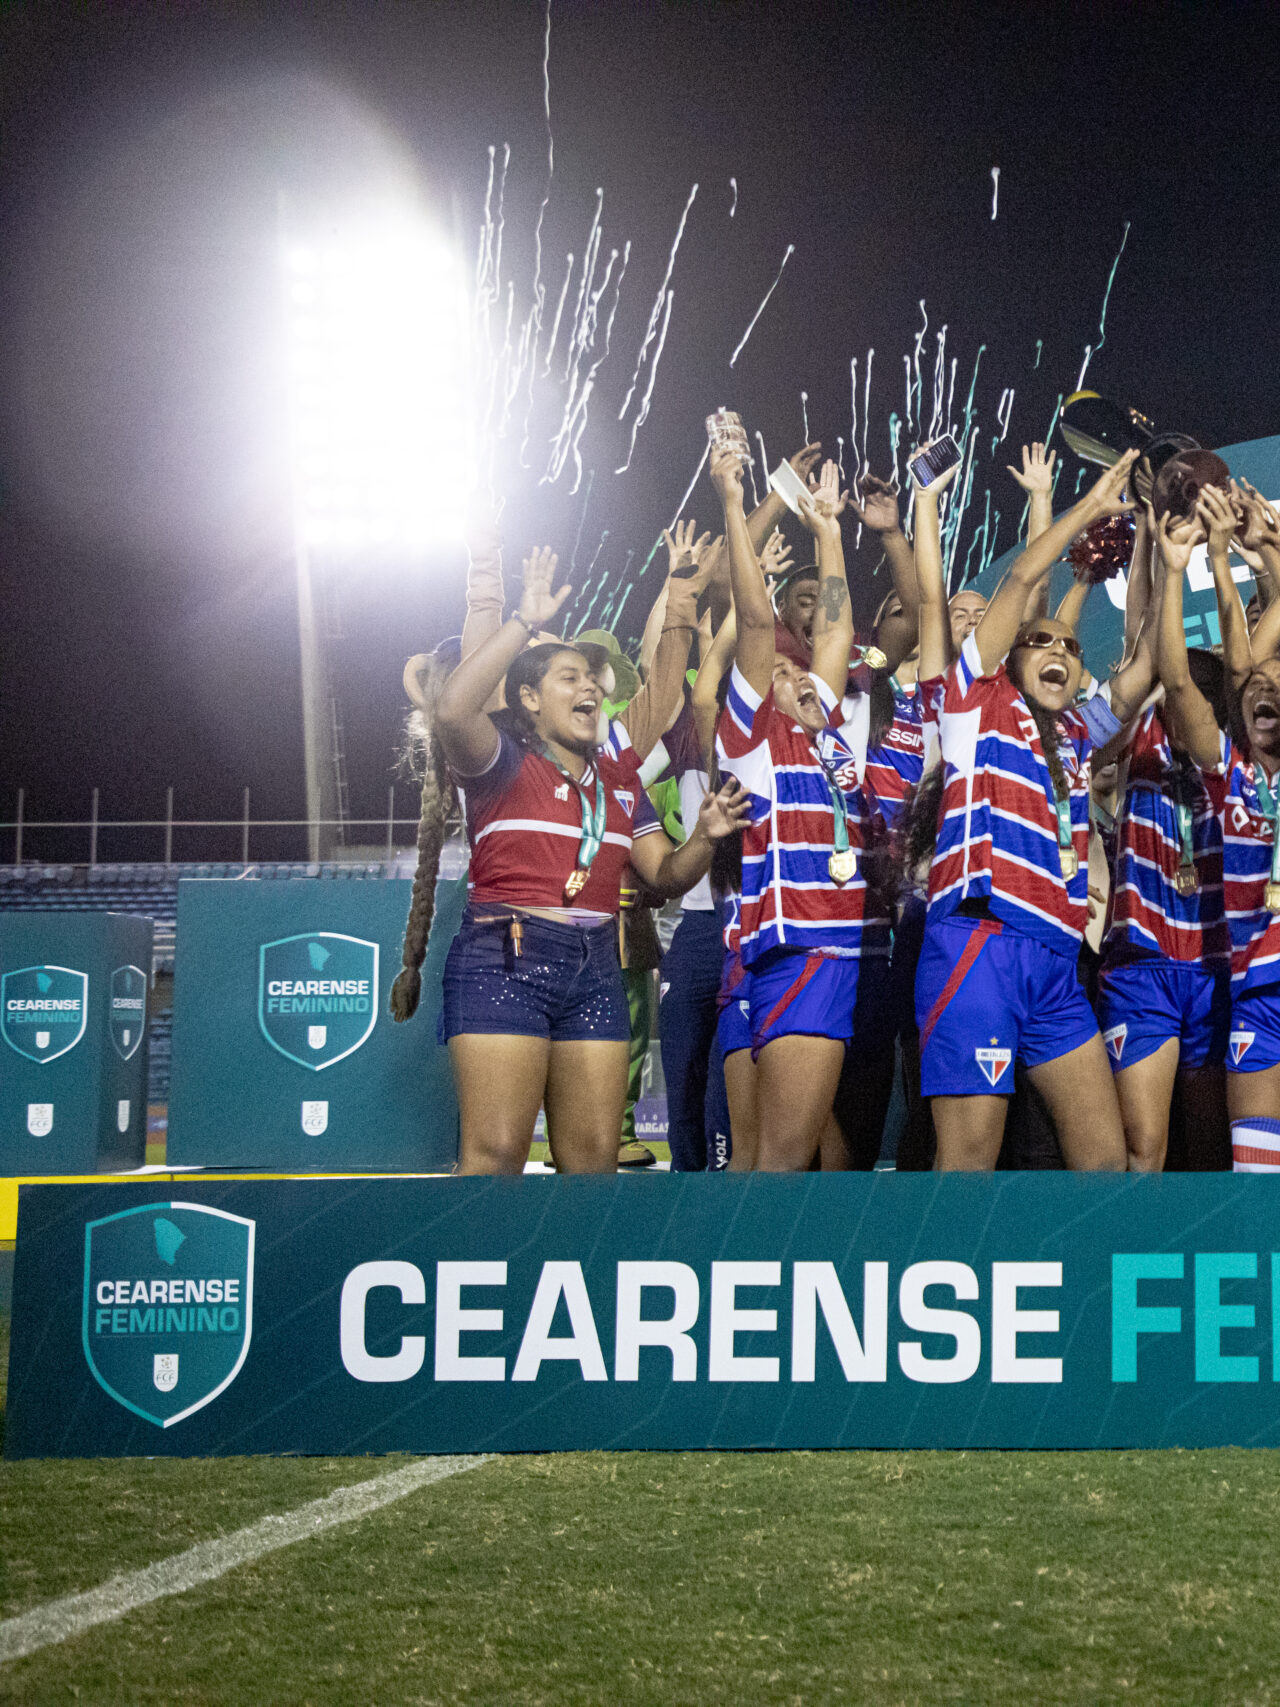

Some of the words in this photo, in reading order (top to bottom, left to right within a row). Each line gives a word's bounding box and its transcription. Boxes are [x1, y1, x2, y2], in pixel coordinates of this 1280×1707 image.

[267, 980, 369, 995] CEARENSE
[7, 1000, 81, 1010] CEARENSE
[267, 997, 370, 1013] FEMININO
[7, 1011, 80, 1023] FEMININO
[304, 1119, 324, 1127] FCF
[716, 1132, 729, 1168] VOLT
[96, 1280, 240, 1305] CEARENSE
[95, 1307, 240, 1333] FEMININO
[341, 1261, 1062, 1384] CEARENSE
[156, 1373, 175, 1382] FCF
